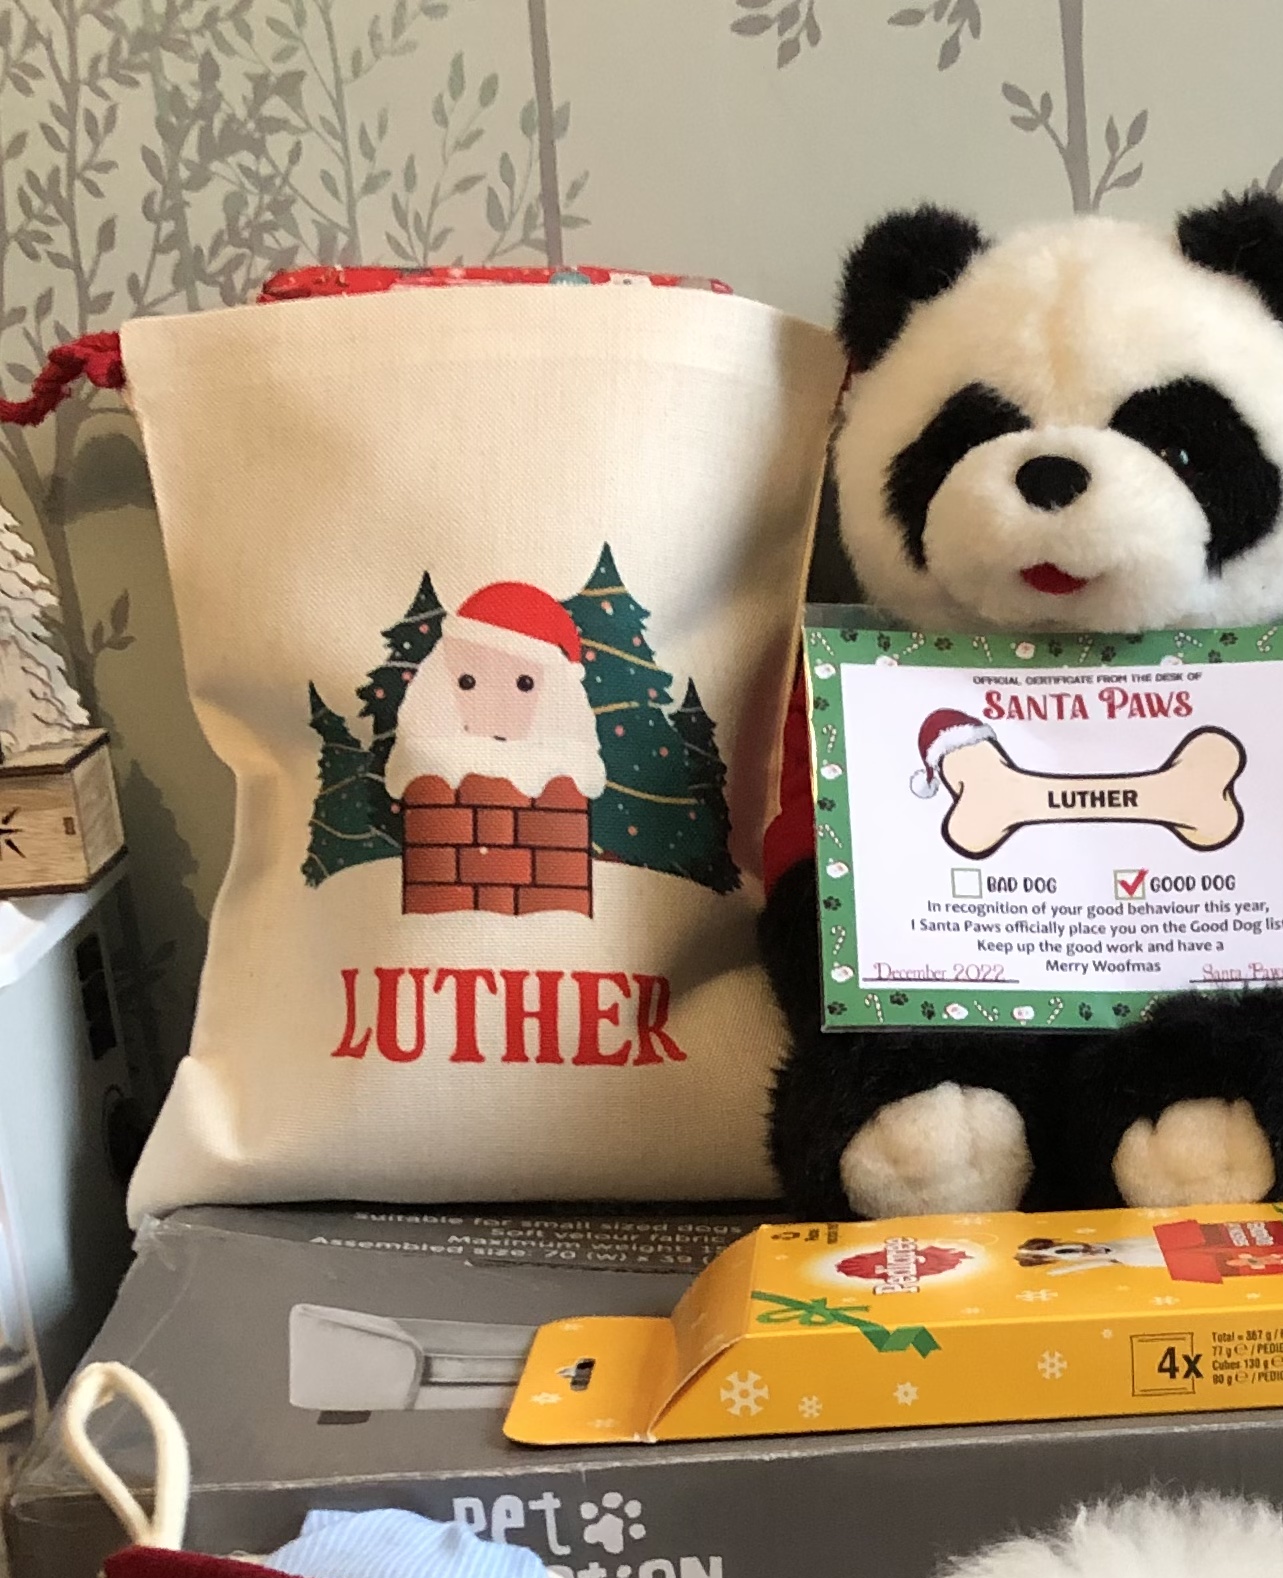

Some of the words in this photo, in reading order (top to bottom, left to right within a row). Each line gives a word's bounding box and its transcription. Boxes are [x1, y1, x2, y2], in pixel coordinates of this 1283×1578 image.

[973, 675, 1022, 686] OFFICIAL
[1025, 674, 1093, 685] CERTIFICATE
[1096, 673, 1127, 684] FROM
[1132, 673, 1152, 683] THE
[1155, 672, 1182, 682] DESK
[1187, 671, 1202, 681] OF
[982, 689, 1090, 721] SANTA
[1098, 686, 1193, 720] PAWS
[1048, 789, 1138, 808] LUTHER
[986, 876, 1018, 893] BAD
[1023, 877, 1058, 894] DOG
[1150, 875, 1196, 893] GOOD
[1201, 874, 1236, 891] DOG
[927, 900, 941, 912] In
[945, 901, 1028, 917] recognition
[1031, 902, 1046, 915] of
[1051, 905, 1083, 918] your
[1087, 902, 1124, 919] good
[1128, 901, 1200, 915] behaviour
[1204, 900, 1231, 913] this
[1235, 902, 1270, 915] year,
[911, 919, 915, 930] I
[920, 919, 960, 932] Santa
[964, 920, 1001, 933] Paws
[1005, 920, 1064, 937] officially
[1069, 922, 1106, 937] place
[1110, 923, 1137, 937] you
[1140, 923, 1158, 934] on
[1163, 921, 1186, 933] the
[1190, 919, 1228, 933] Good
[1233, 919, 1262, 934] Dog
[977, 939, 1013, 954] Keep
[1017, 941, 1035, 955] up
[1039, 940, 1062, 953] the
[1066, 940, 1102, 956] good
[1105, 940, 1143, 953] work
[1148, 940, 1174, 952] and
[1177, 939, 1212, 952] have
[1216, 941, 1224, 951] a
[873, 962, 947, 980] December
[953, 963, 1005, 980] 2022
[1045, 959, 1088, 975] Merry
[1093, 960, 1161, 973] Woofmas
[1202, 963, 1242, 981] Santa
[330, 967, 687, 1066] LUTHER
[474, 1217, 512, 1227] for
[521, 1218, 590, 1230] small
[677, 1224, 742, 1235] dogs
[309, 1236, 463, 1253] Assembled
[448, 1235, 581, 1249] Maximum
[555, 1231, 639, 1242] velour
[650, 1233, 725, 1244] fabric
[1212, 1331, 1235, 1343] Total
[1157, 1345, 1203, 1380] 4x
